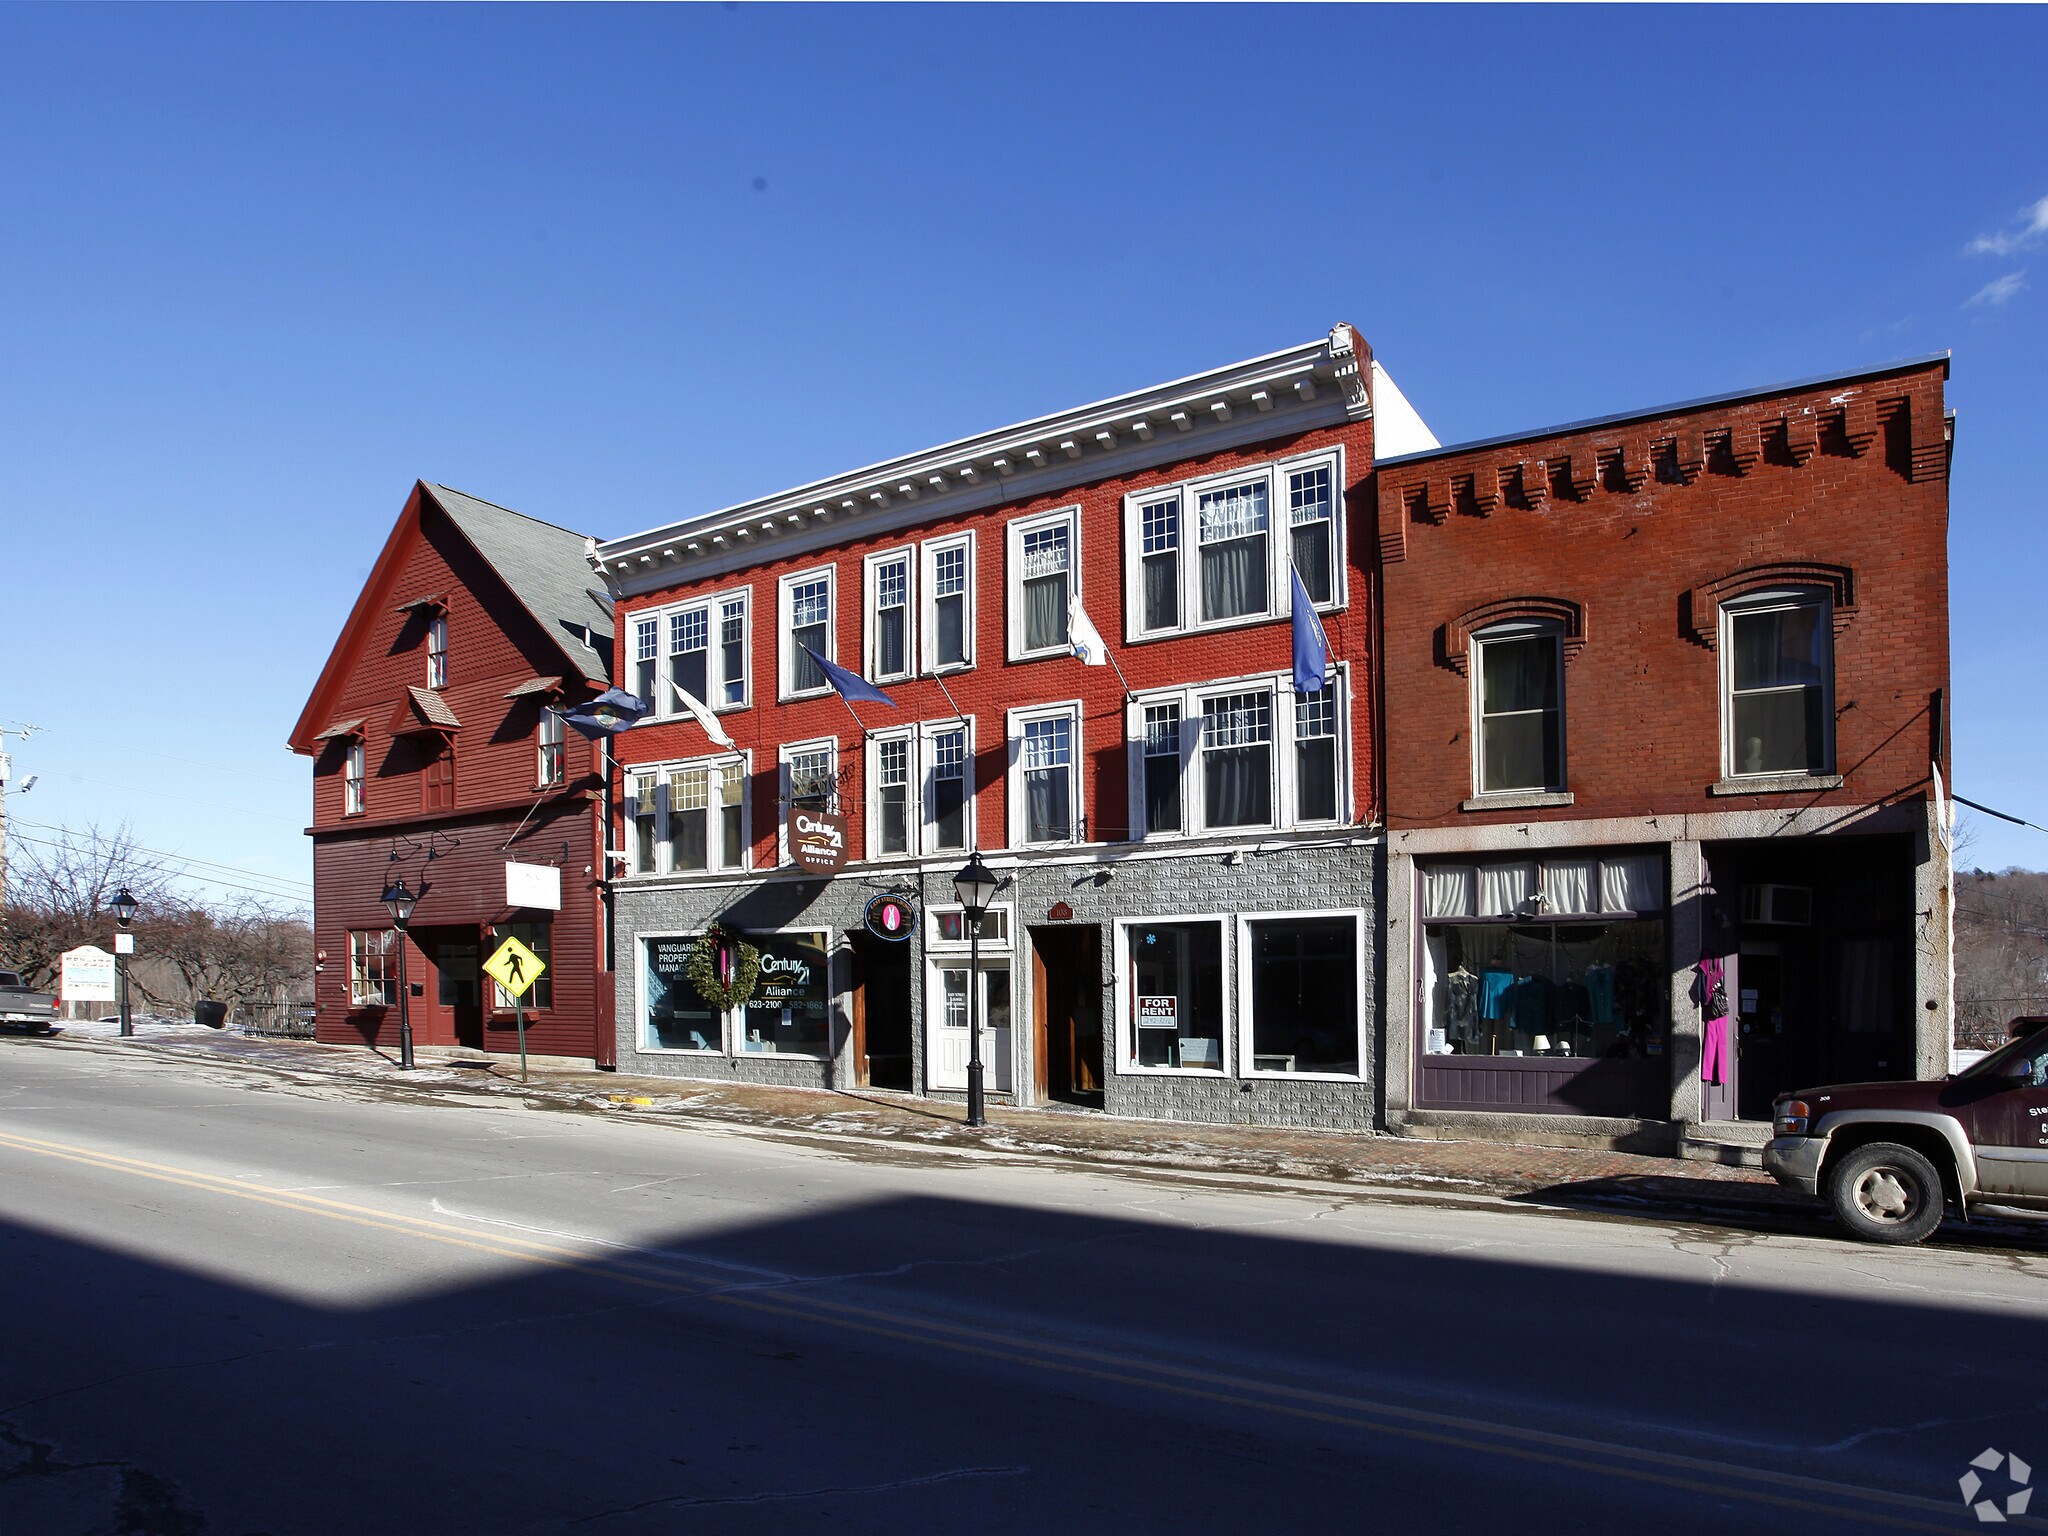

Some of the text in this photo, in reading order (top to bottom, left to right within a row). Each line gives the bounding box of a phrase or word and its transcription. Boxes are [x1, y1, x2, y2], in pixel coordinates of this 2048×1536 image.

[801, 844, 838, 857] Alliance
[805, 857, 835, 866] OFFICE
[658, 953, 691, 963] PROPER
[761, 953, 810, 985] Century 21
[765, 986, 805, 996] Alliance
[749, 1000, 823, 1010] 623-2100 582-1862
[1145, 999, 1170, 1007] FOR
[1141, 1008, 1174, 1016] RENT
[2028, 1106, 2048, 1117] Ste
